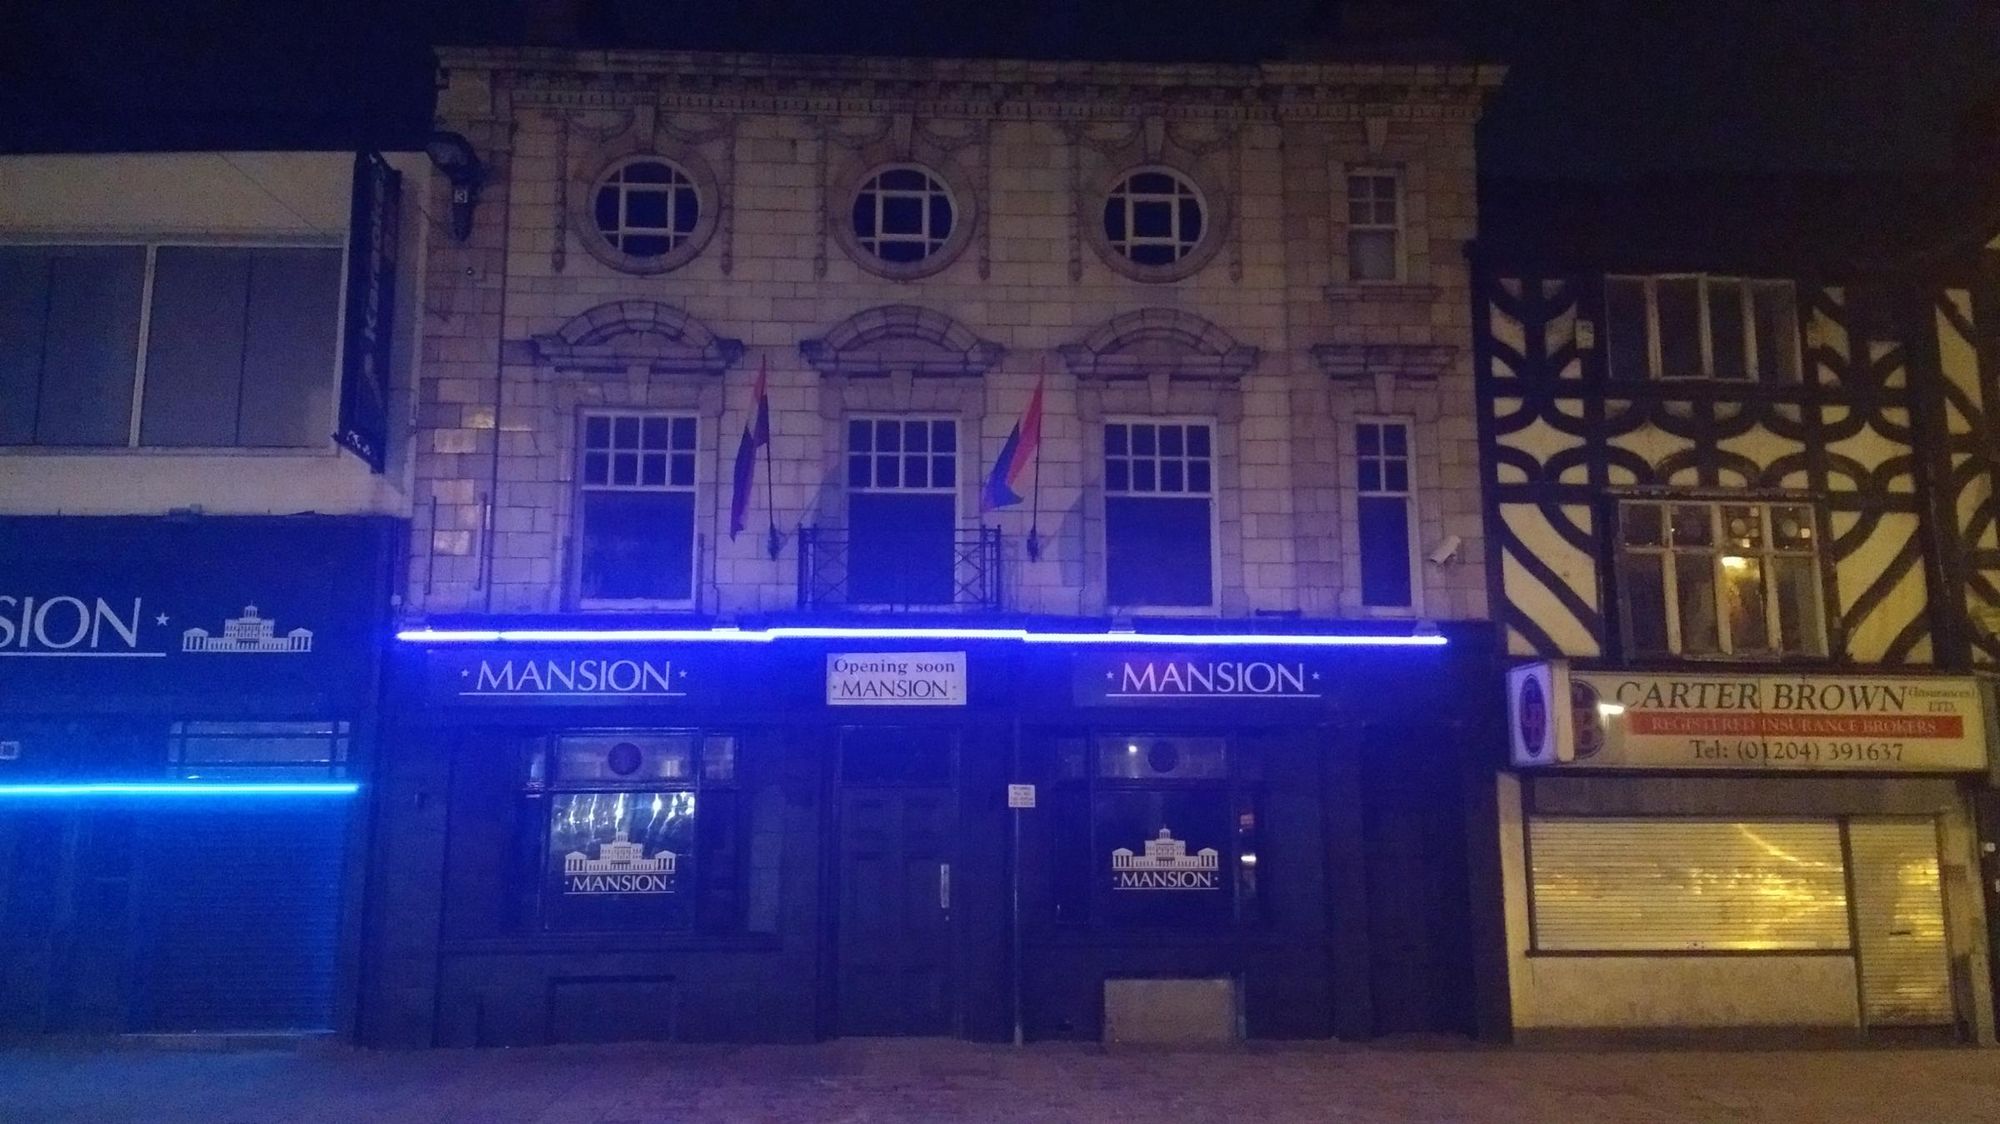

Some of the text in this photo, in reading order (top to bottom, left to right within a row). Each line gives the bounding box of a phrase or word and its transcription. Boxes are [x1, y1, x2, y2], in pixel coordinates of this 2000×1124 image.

[476, 660, 671, 691] MANSION
[833, 659, 955, 675] Opening soon
[1122, 662, 1304, 693] MANSION
[840, 679, 948, 698] MANSION
[1616, 681, 1908, 712] CARTER BROWN
[1651, 717, 1938, 734] REGISTERED INSURANCE BROKERS
[1690, 740, 1904, 765] Tel: (01204) 391637
[571, 875, 667, 892] MANSION
[1120, 871, 1211, 888] MANSION
